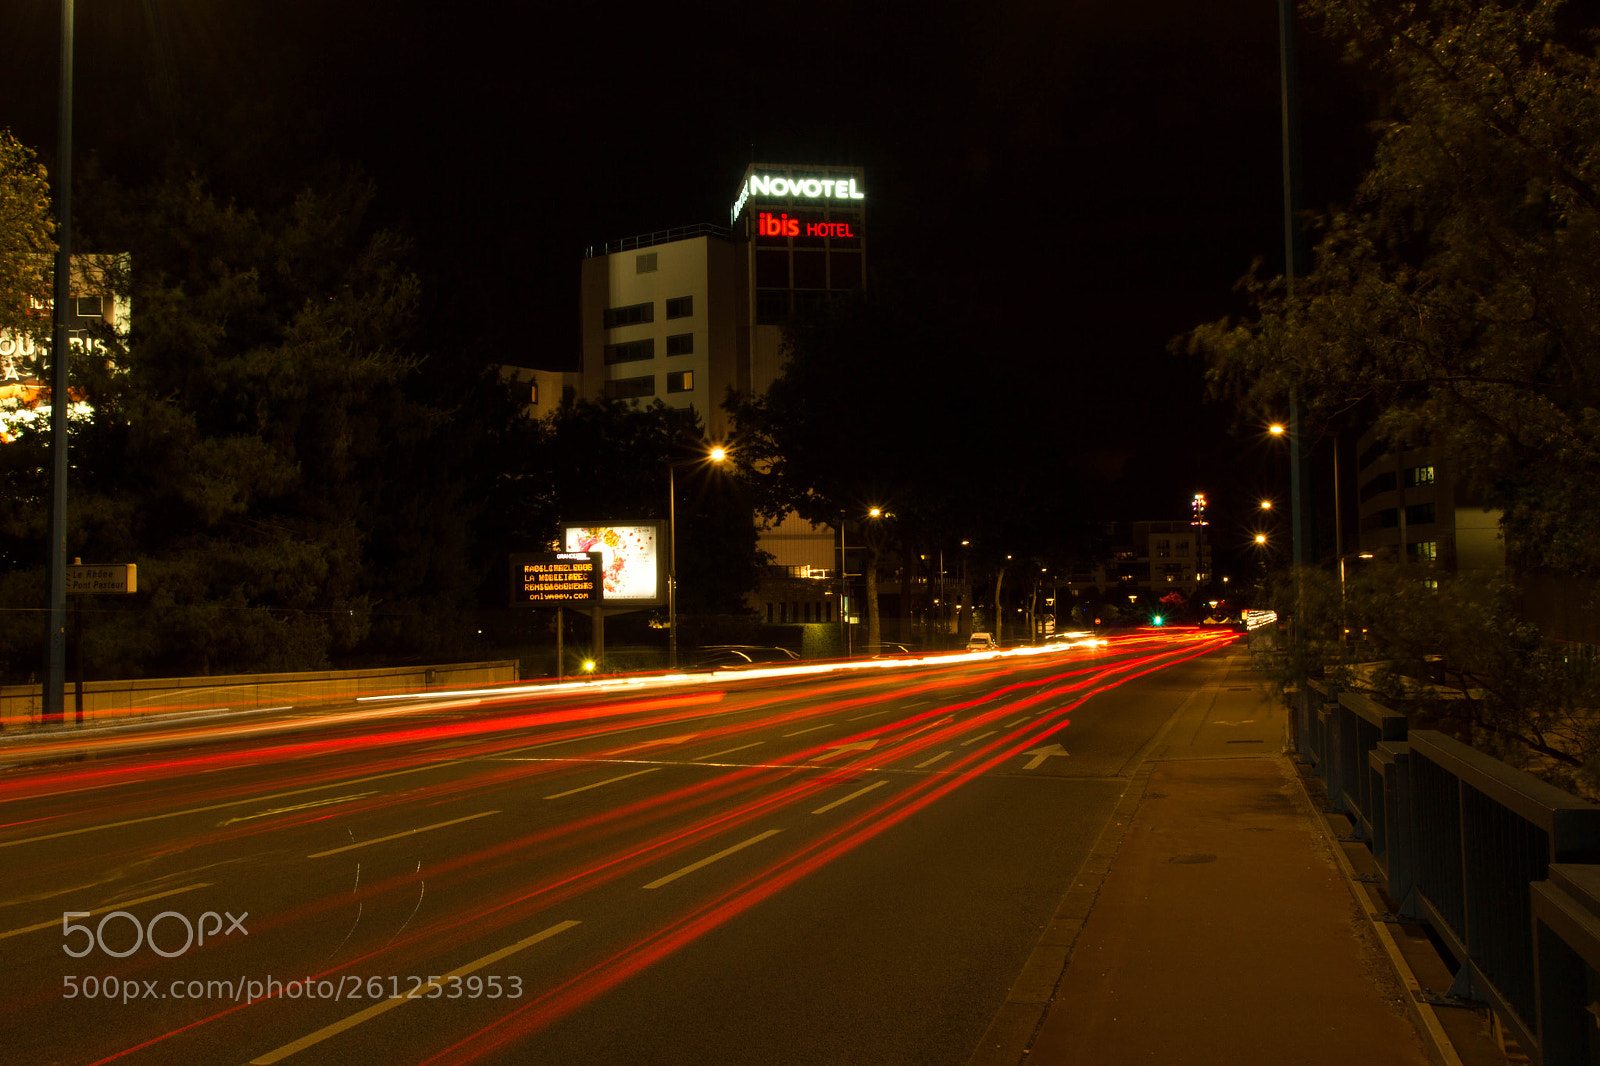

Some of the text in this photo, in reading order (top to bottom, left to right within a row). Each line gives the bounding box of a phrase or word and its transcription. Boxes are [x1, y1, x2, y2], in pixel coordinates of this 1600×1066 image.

[750, 174, 865, 199] NOVOTEL
[759, 212, 854, 238] ibis HOTEL
[72, 569, 113, 578] Le Rhône
[73, 581, 123, 589] Pont Pasteur
